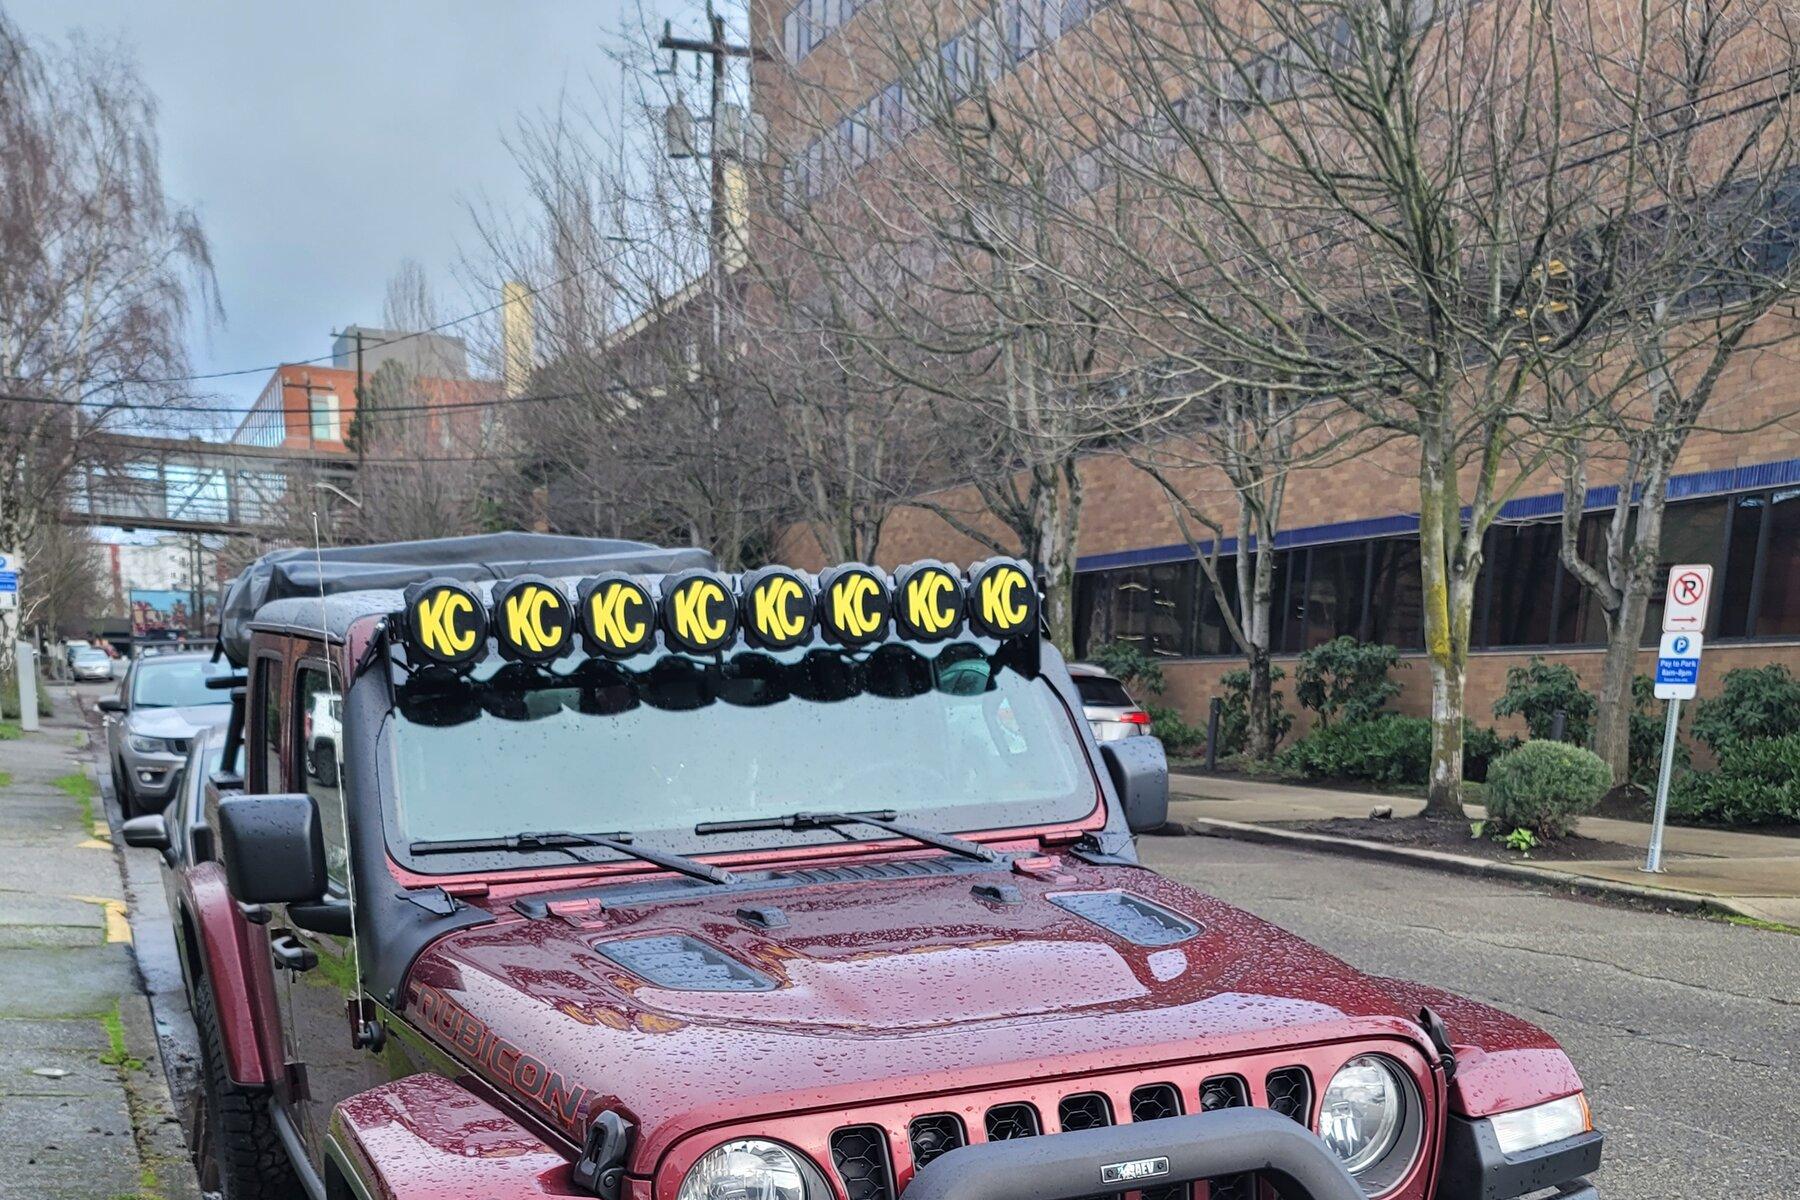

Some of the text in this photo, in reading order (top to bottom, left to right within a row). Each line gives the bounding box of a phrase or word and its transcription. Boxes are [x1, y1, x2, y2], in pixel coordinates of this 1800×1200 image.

[418, 590, 476, 656] KC
[506, 586, 562, 652] KC
[591, 584, 646, 648] KC
[675, 581, 726, 644] KC
[755, 577, 805, 640] KC
[832, 574, 881, 637] KC
[907, 571, 955, 632] KC
[982, 568, 1027, 629] KC
[1660, 660, 1672, 668] Pay
[415, 983, 587, 1124] RUBICON
